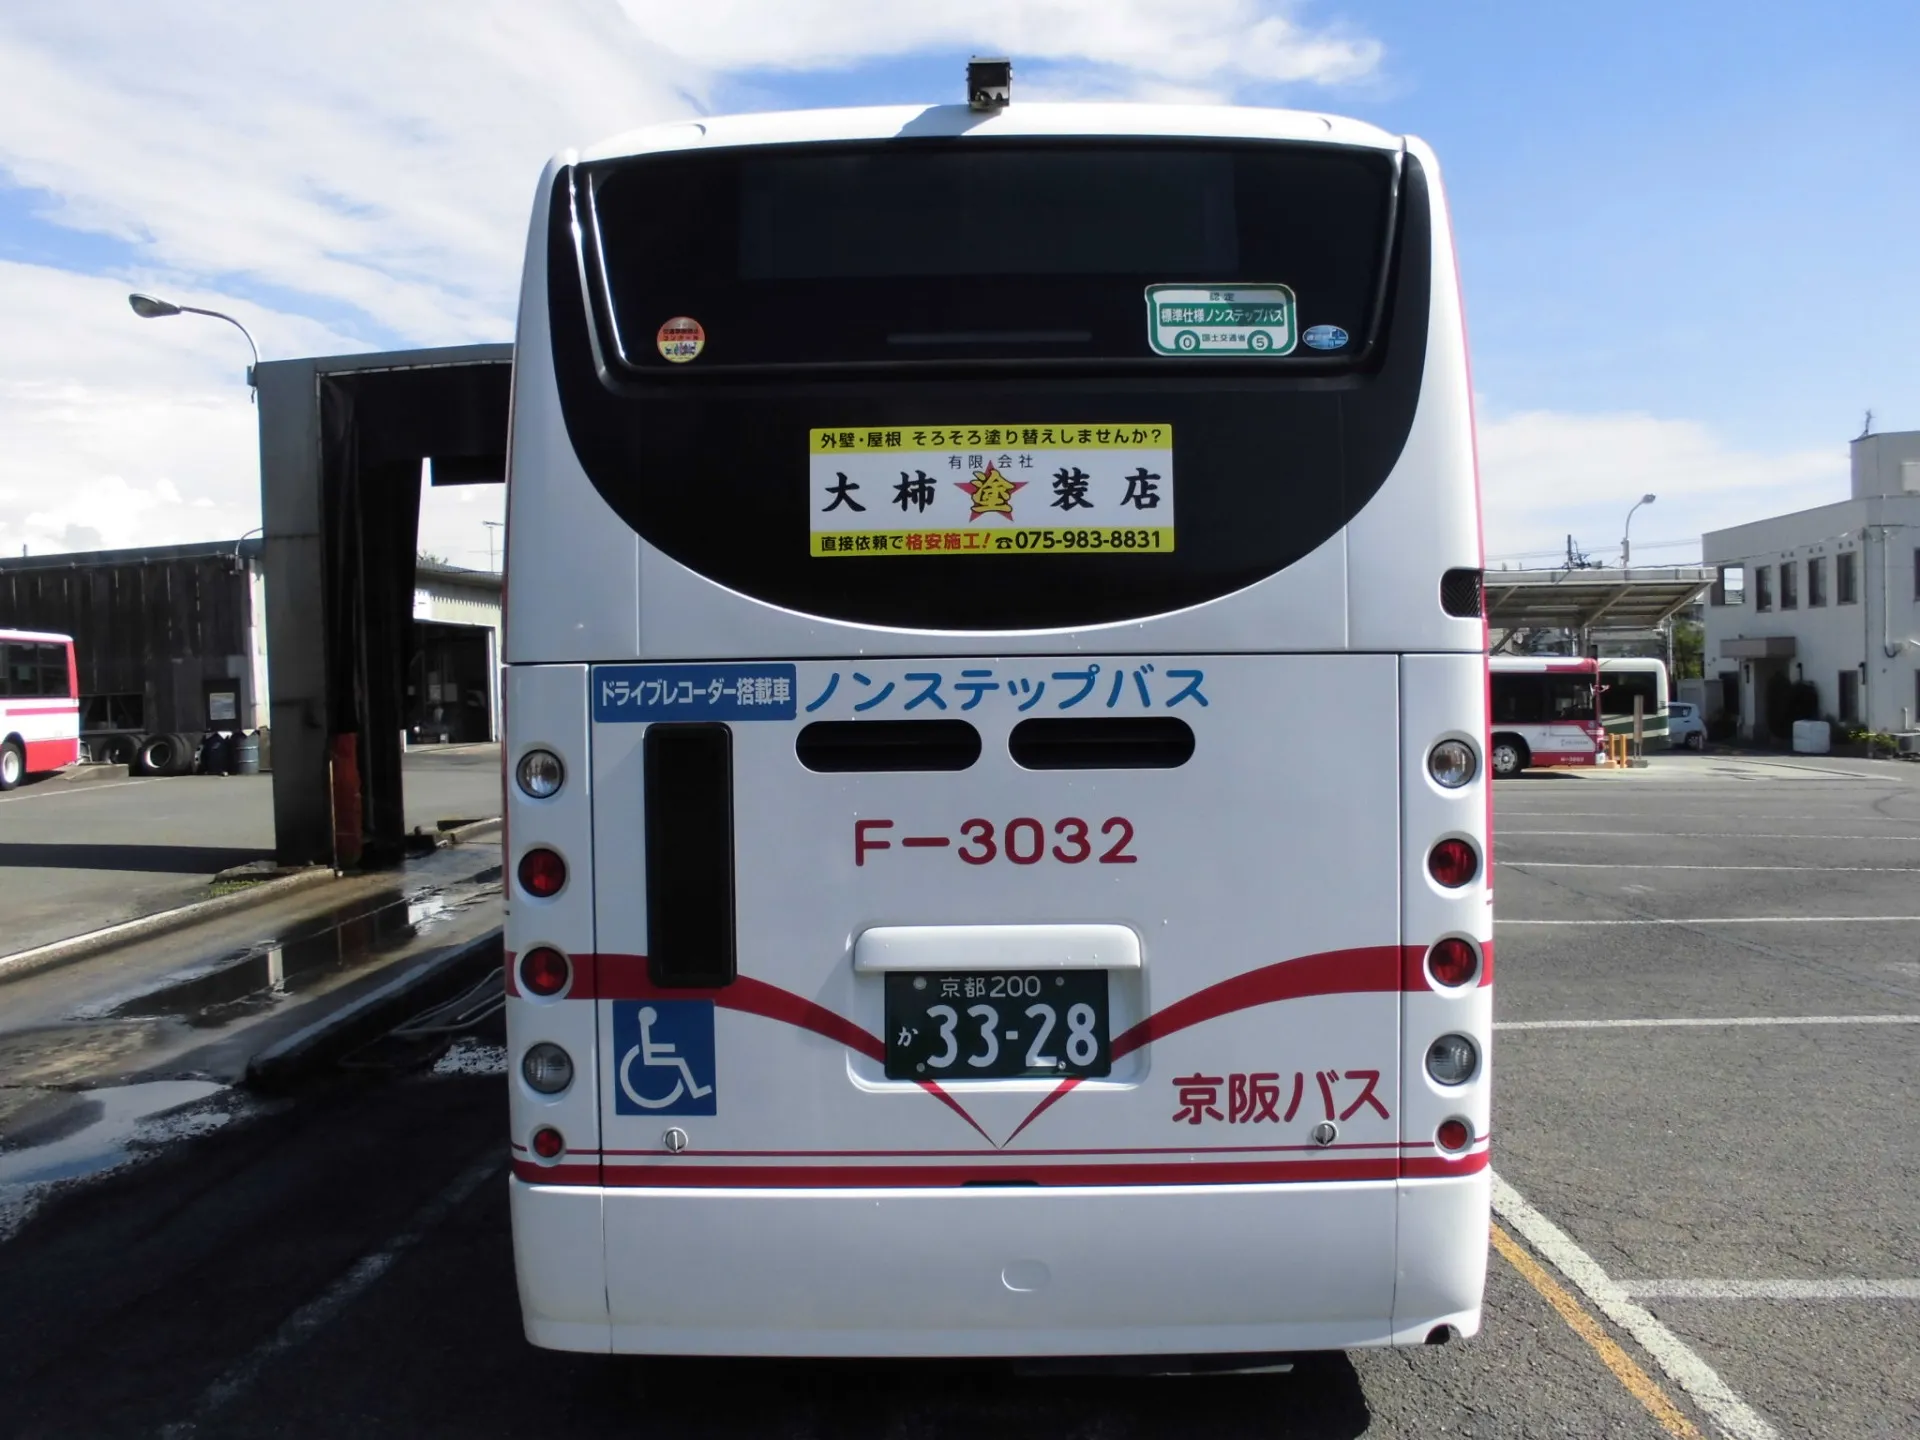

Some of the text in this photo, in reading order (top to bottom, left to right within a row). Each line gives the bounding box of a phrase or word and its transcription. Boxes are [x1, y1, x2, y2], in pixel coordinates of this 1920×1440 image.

[1161, 307, 1283, 323] 標準仕様ノンステップバス
[1202, 333, 1245, 343] 国土交通省
[1256, 337, 1264, 348] 5
[821, 431, 902, 448] 外壁・屋根
[1015, 531, 1160, 549] 075-983-8831
[601, 677, 790, 706] ドライブレコーダー搭載車
[806, 663, 1208, 713] ノンステップバス
[855, 817, 1137, 866] F-3032
[897, 1003, 1098, 1068] か 33-28
[1172, 1069, 1390, 1124] 京阪バス
